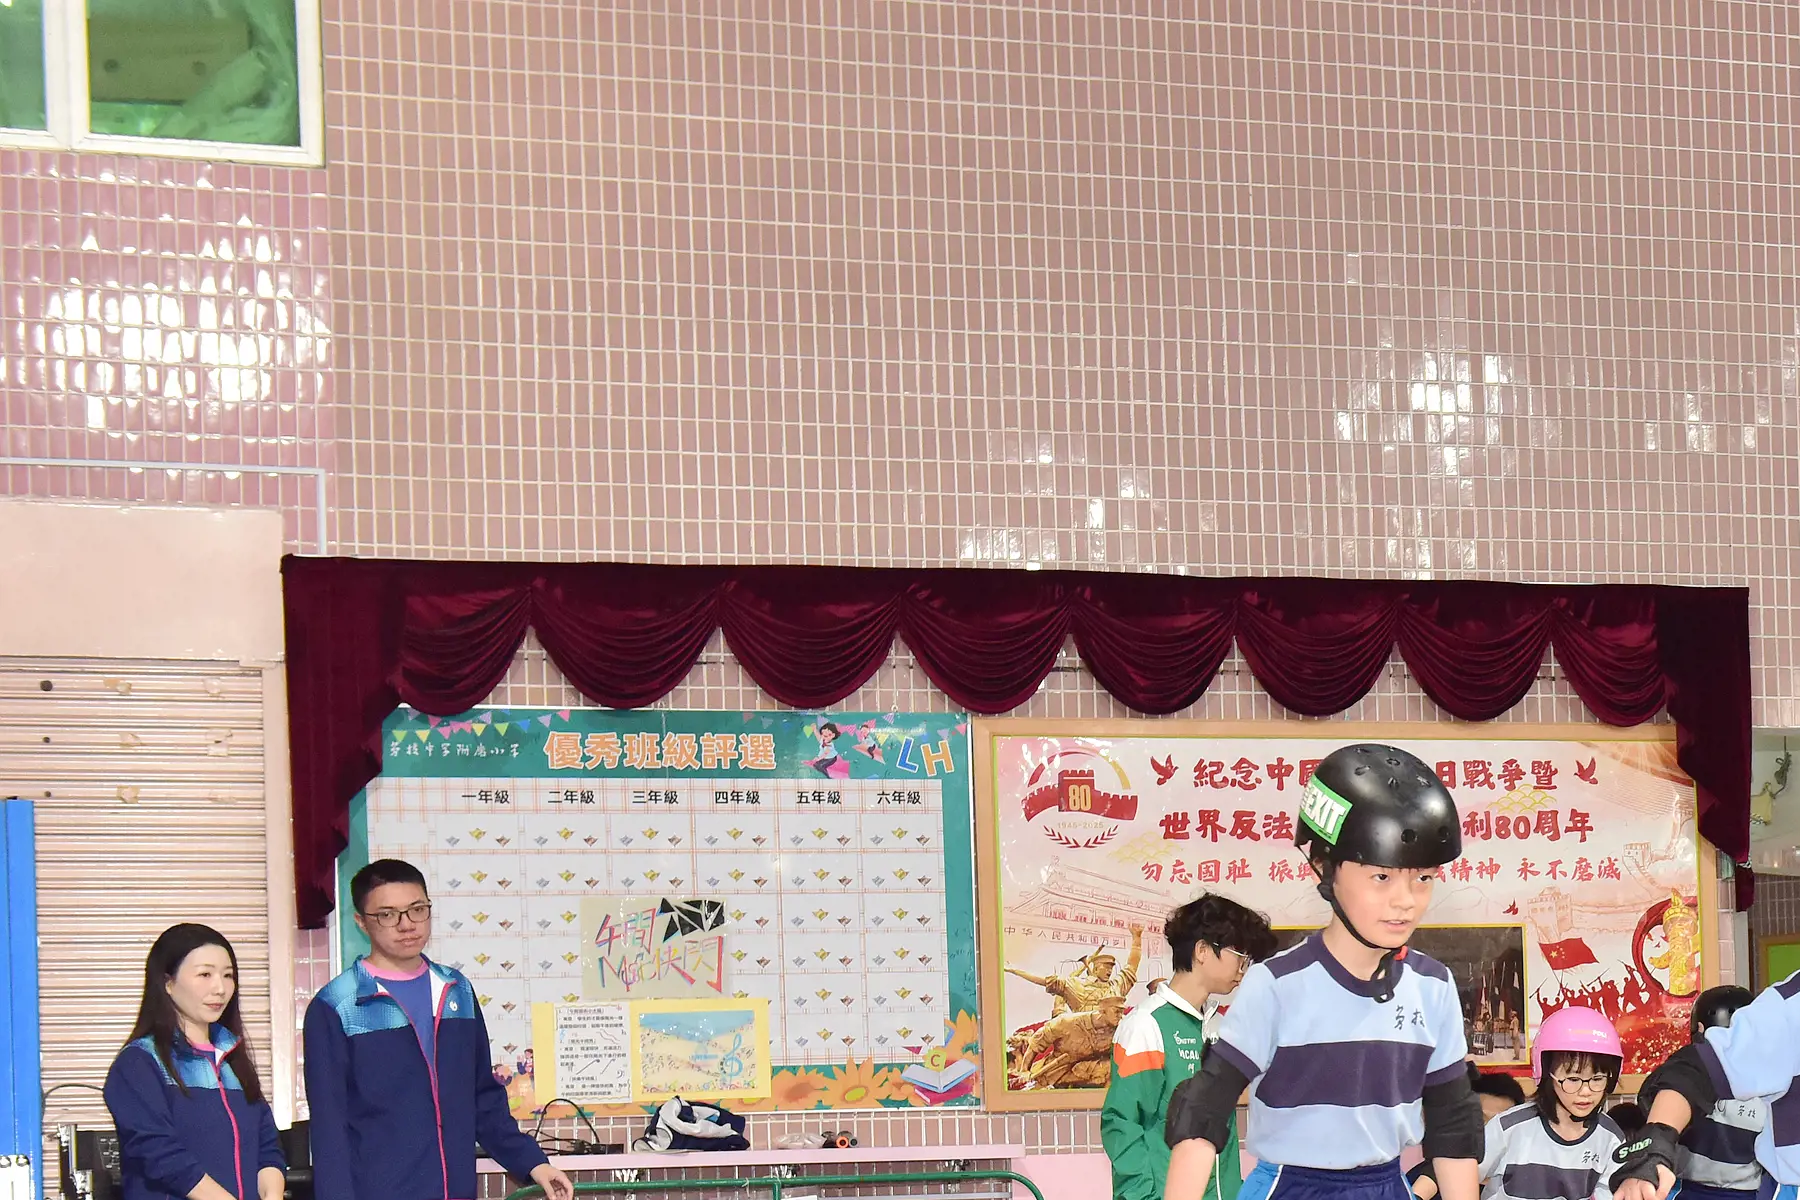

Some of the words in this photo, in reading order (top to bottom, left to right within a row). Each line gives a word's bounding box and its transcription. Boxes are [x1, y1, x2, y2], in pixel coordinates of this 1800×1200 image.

[544, 732, 776, 770] 優秀班級評選
[462, 790, 510, 804] 一年級
[548, 790, 595, 804] 二年級
[632, 790, 679, 804] 三年級
[715, 790, 760, 804] 四年級
[796, 790, 841, 804] 五年級
[876, 790, 921, 804] 六年級
[1068, 784, 1091, 811] 80
